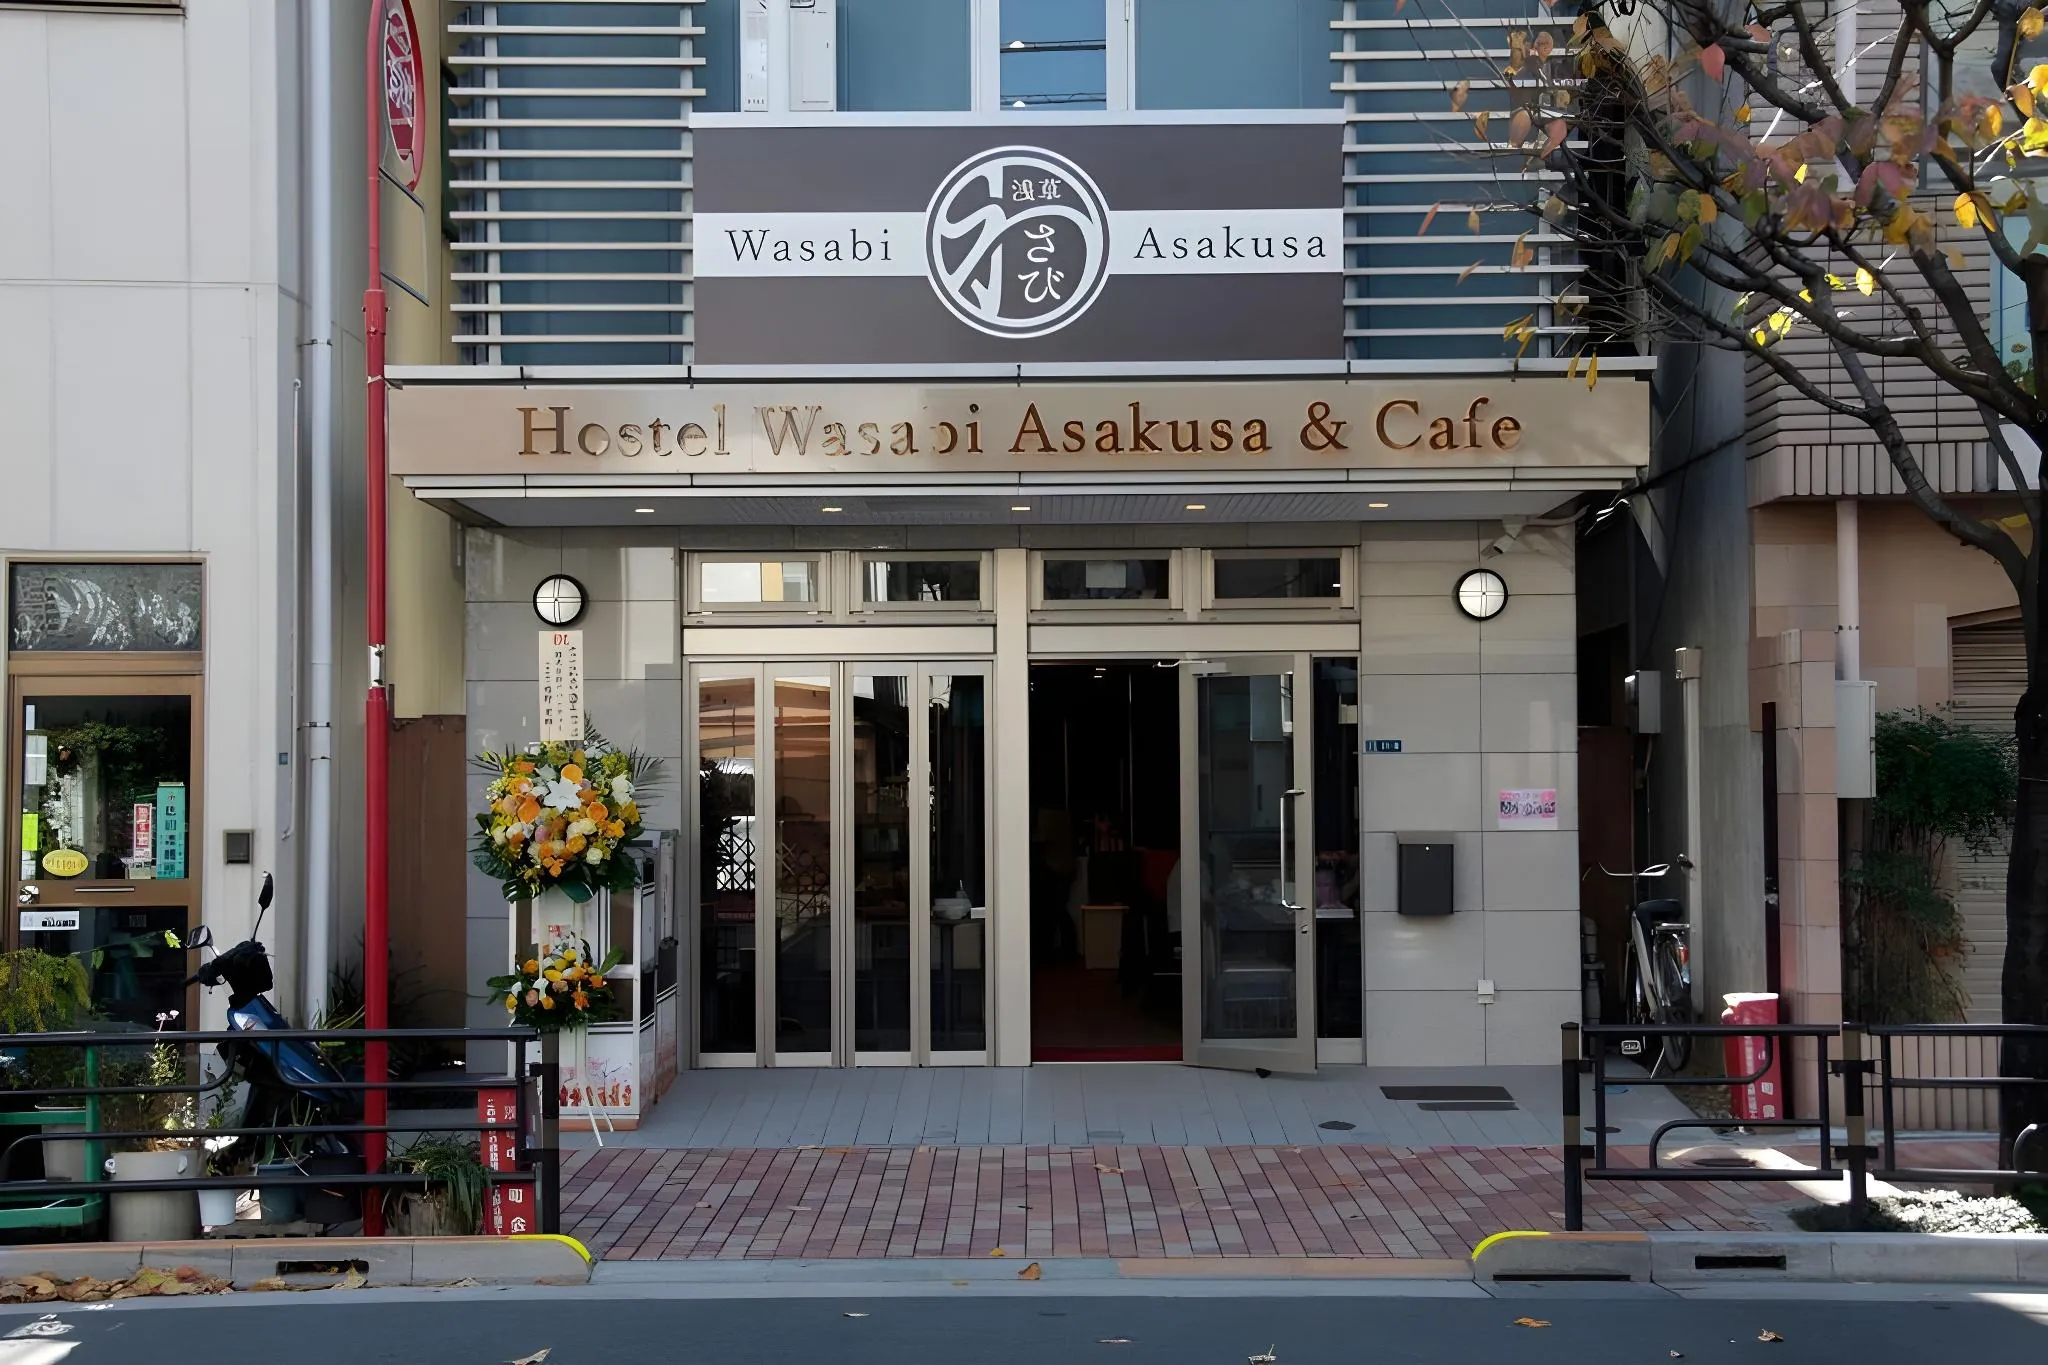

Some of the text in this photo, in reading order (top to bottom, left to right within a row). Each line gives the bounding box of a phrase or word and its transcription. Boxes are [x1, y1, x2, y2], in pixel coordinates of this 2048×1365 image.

[724, 228, 892, 262] Wasabi
[1133, 225, 1326, 260] Asakusa
[516, 403, 731, 457] Hostel
[1008, 401, 1272, 454] Asakusa
[1299, 400, 1349, 451] &
[1376, 396, 1523, 451] Cafe
